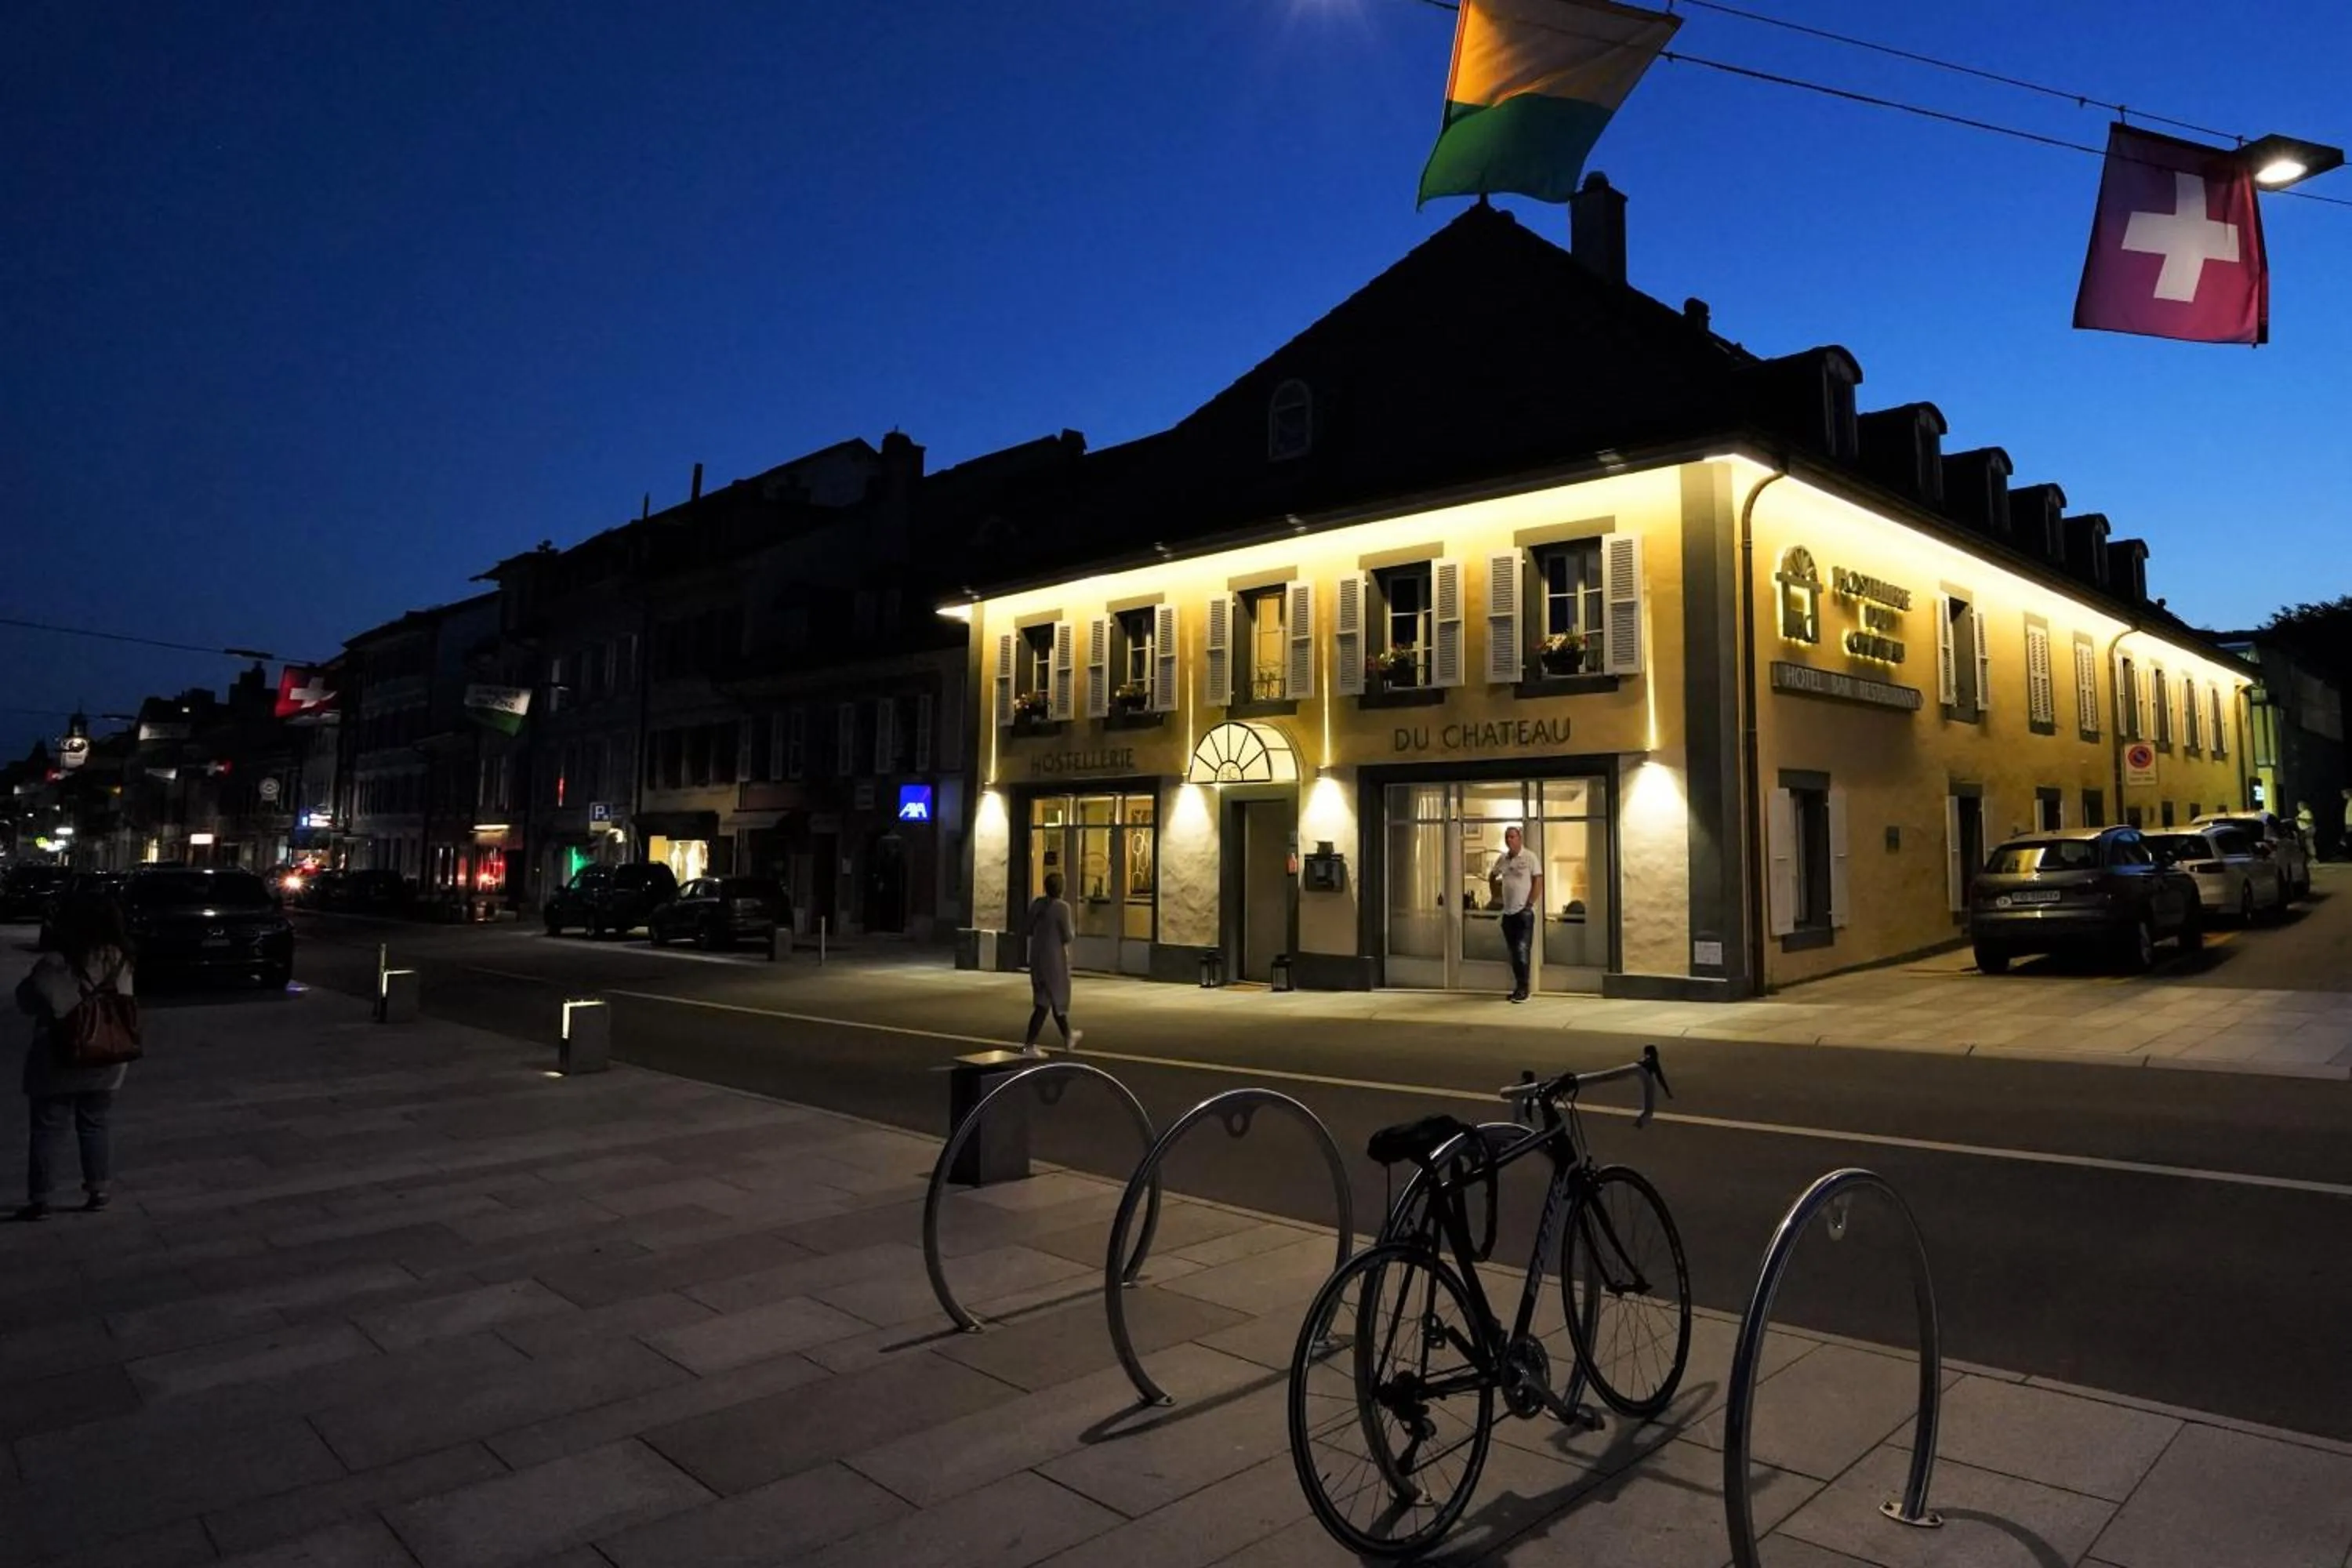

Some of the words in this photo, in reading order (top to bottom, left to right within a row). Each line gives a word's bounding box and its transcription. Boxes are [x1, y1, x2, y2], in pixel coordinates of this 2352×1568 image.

[1784, 666, 1824, 691] HOTEL
[1394, 725, 1430, 752] DU
[1442, 716, 1572, 750] CHATEAU
[1030, 747, 1134, 775] HOSTELLERIE
[898, 801, 928, 818] AXA
